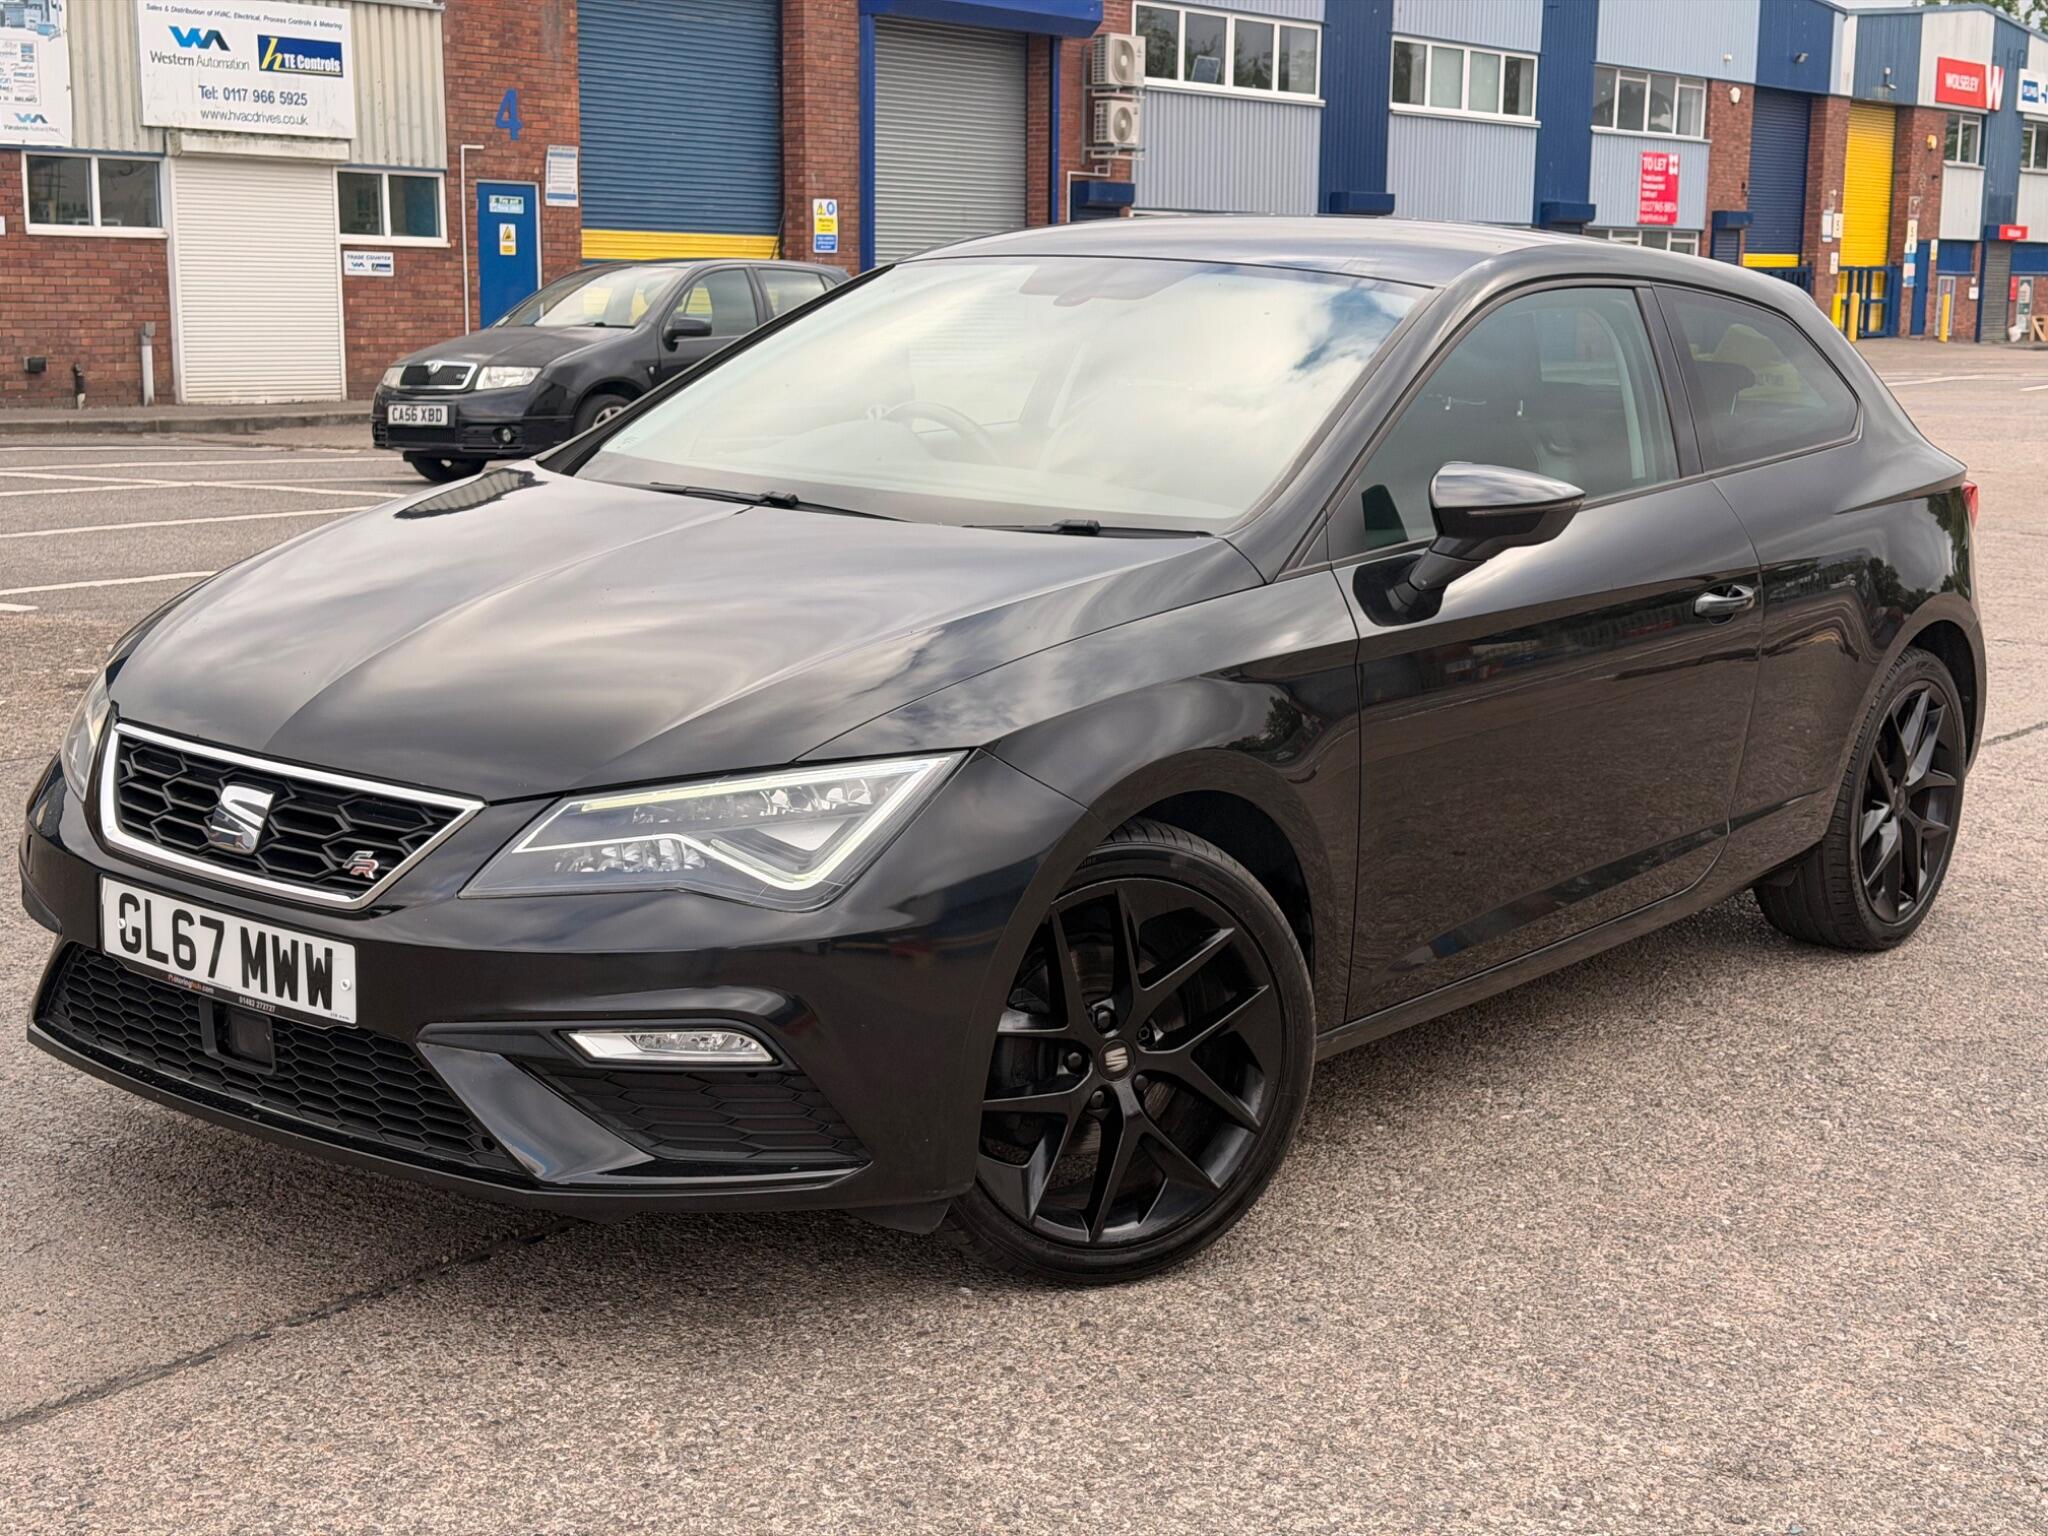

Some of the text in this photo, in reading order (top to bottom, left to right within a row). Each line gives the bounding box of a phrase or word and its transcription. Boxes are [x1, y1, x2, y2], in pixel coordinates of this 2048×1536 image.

[170, 5, 205, 15] Distribution
[288, 17, 312, 27] Controls
[149, 50, 251, 71] Western Automation
[296, 54, 341, 73] Controls
[198, 85, 308, 106] Tel: 0117 966 5925
[495, 88, 524, 141] 4
[1643, 157, 1667, 171] TO LET
[392, 407, 443, 423] CA56 XBD
[342, 850, 379, 880] FR
[118, 892, 333, 1011] GL67 MWW
